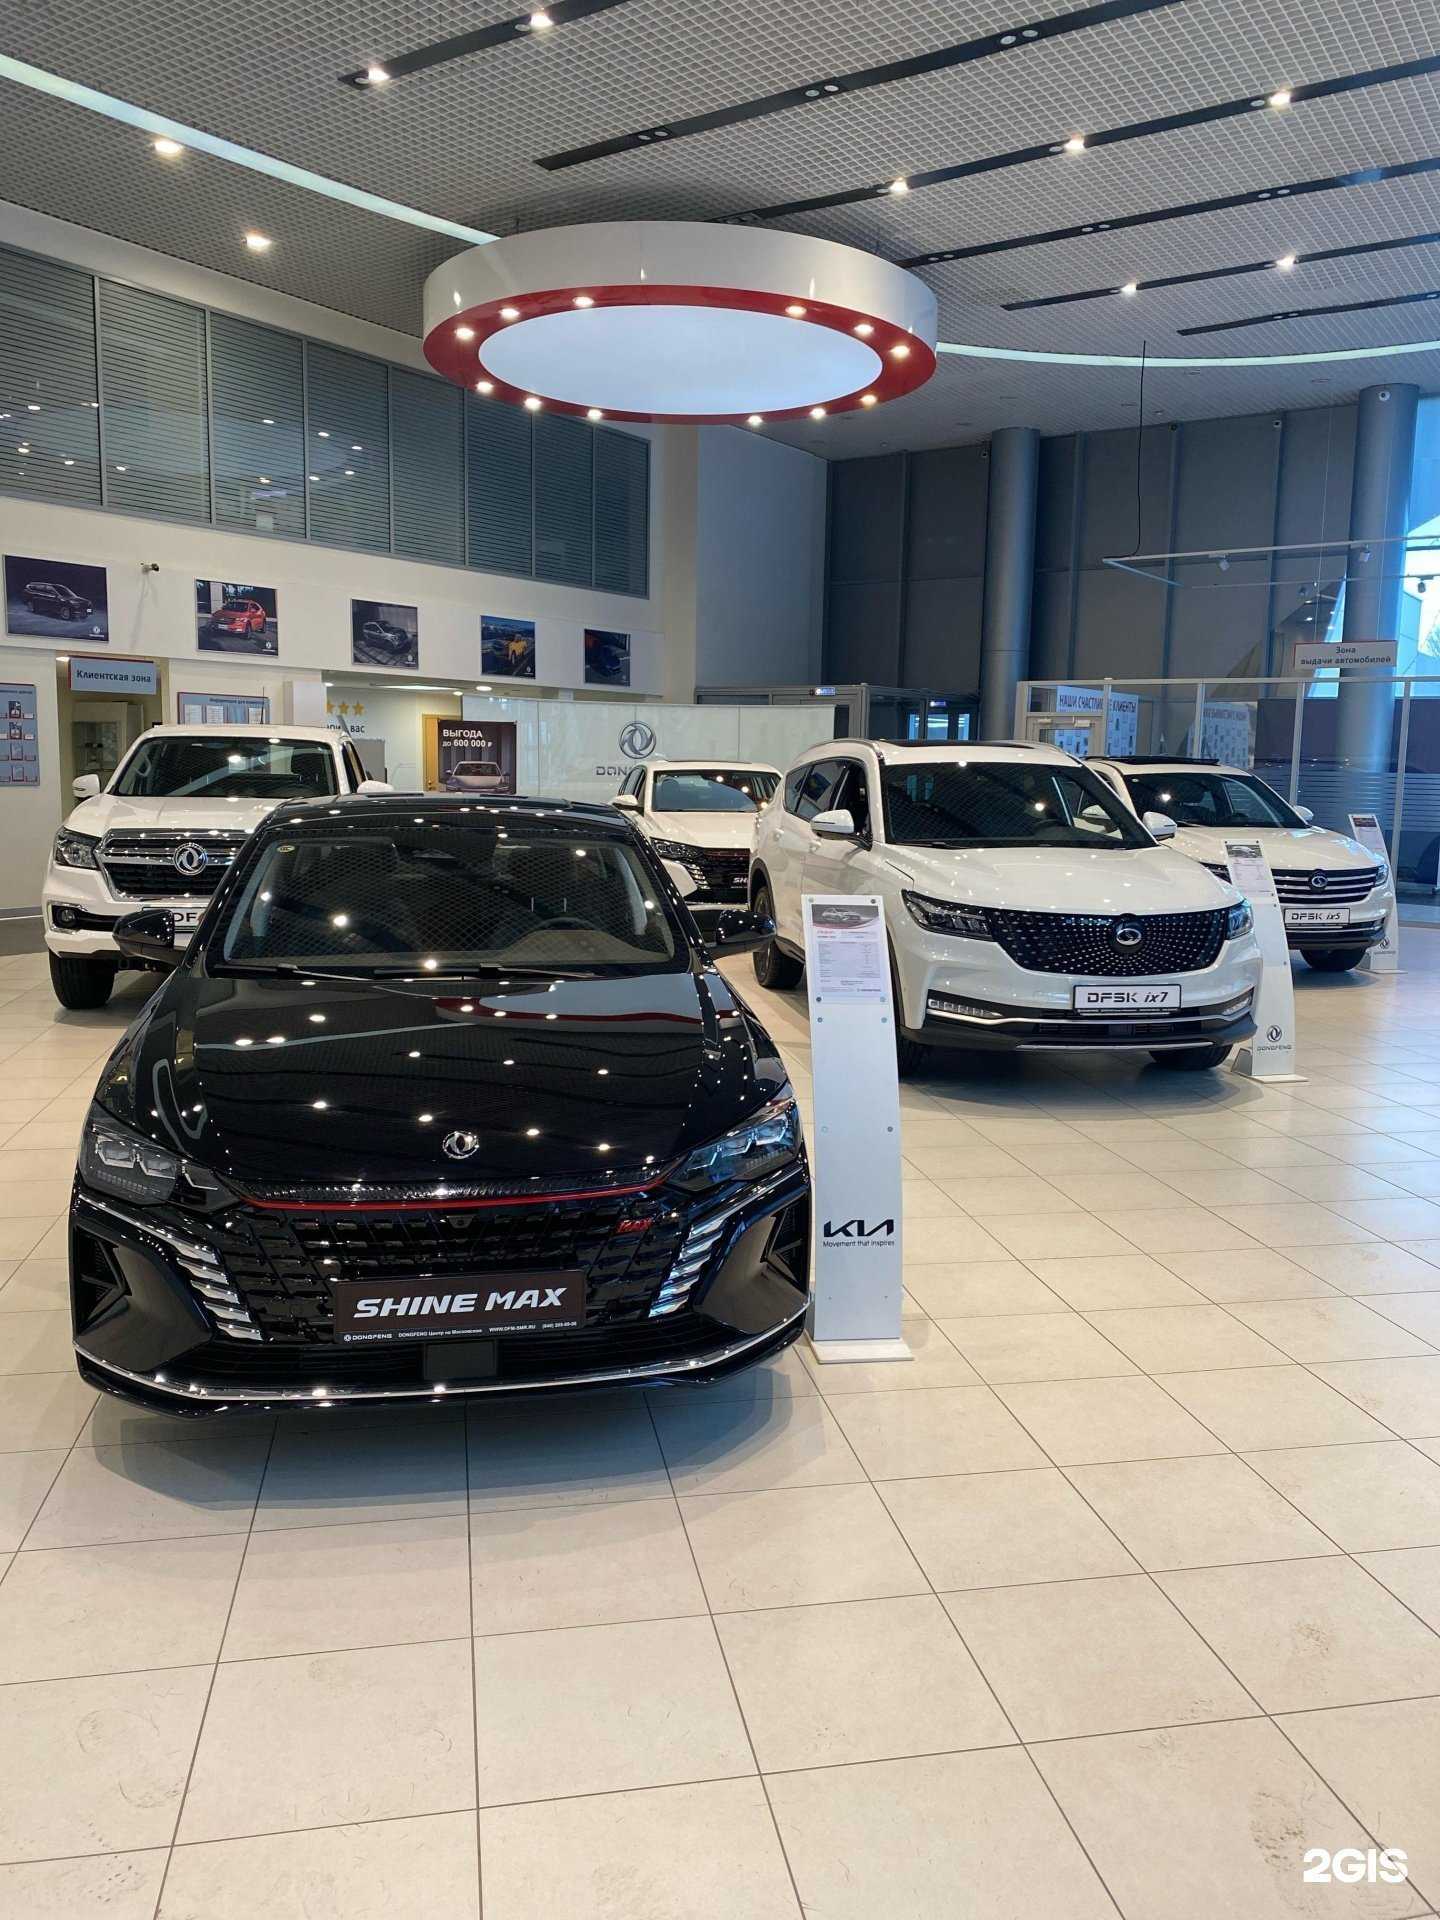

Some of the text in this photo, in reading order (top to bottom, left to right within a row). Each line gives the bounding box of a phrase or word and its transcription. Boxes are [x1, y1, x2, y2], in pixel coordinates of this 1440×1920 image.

[1335, 646, 1356, 654] Зона
[1300, 656, 1391, 666] выдачи автомобилей
[76, 669, 151, 683] Клиентская зона
[1059, 695, 1077, 708] НАШИ
[442, 729, 483, 739] ВЫГОДА
[453, 739, 469, 747] 600
[470, 739, 486, 748] 000
[1291, 912, 1322, 921] DFSK
[1087, 991, 1169, 1003] DFSK ix7
[823, 1218, 894, 1238] KIA
[822, 1240, 856, 1248] Movement
[871, 1240, 895, 1248] inspires
[353, 1287, 568, 1318] SHINE MAX
[352, 1333, 393, 1341] DONGFENG
